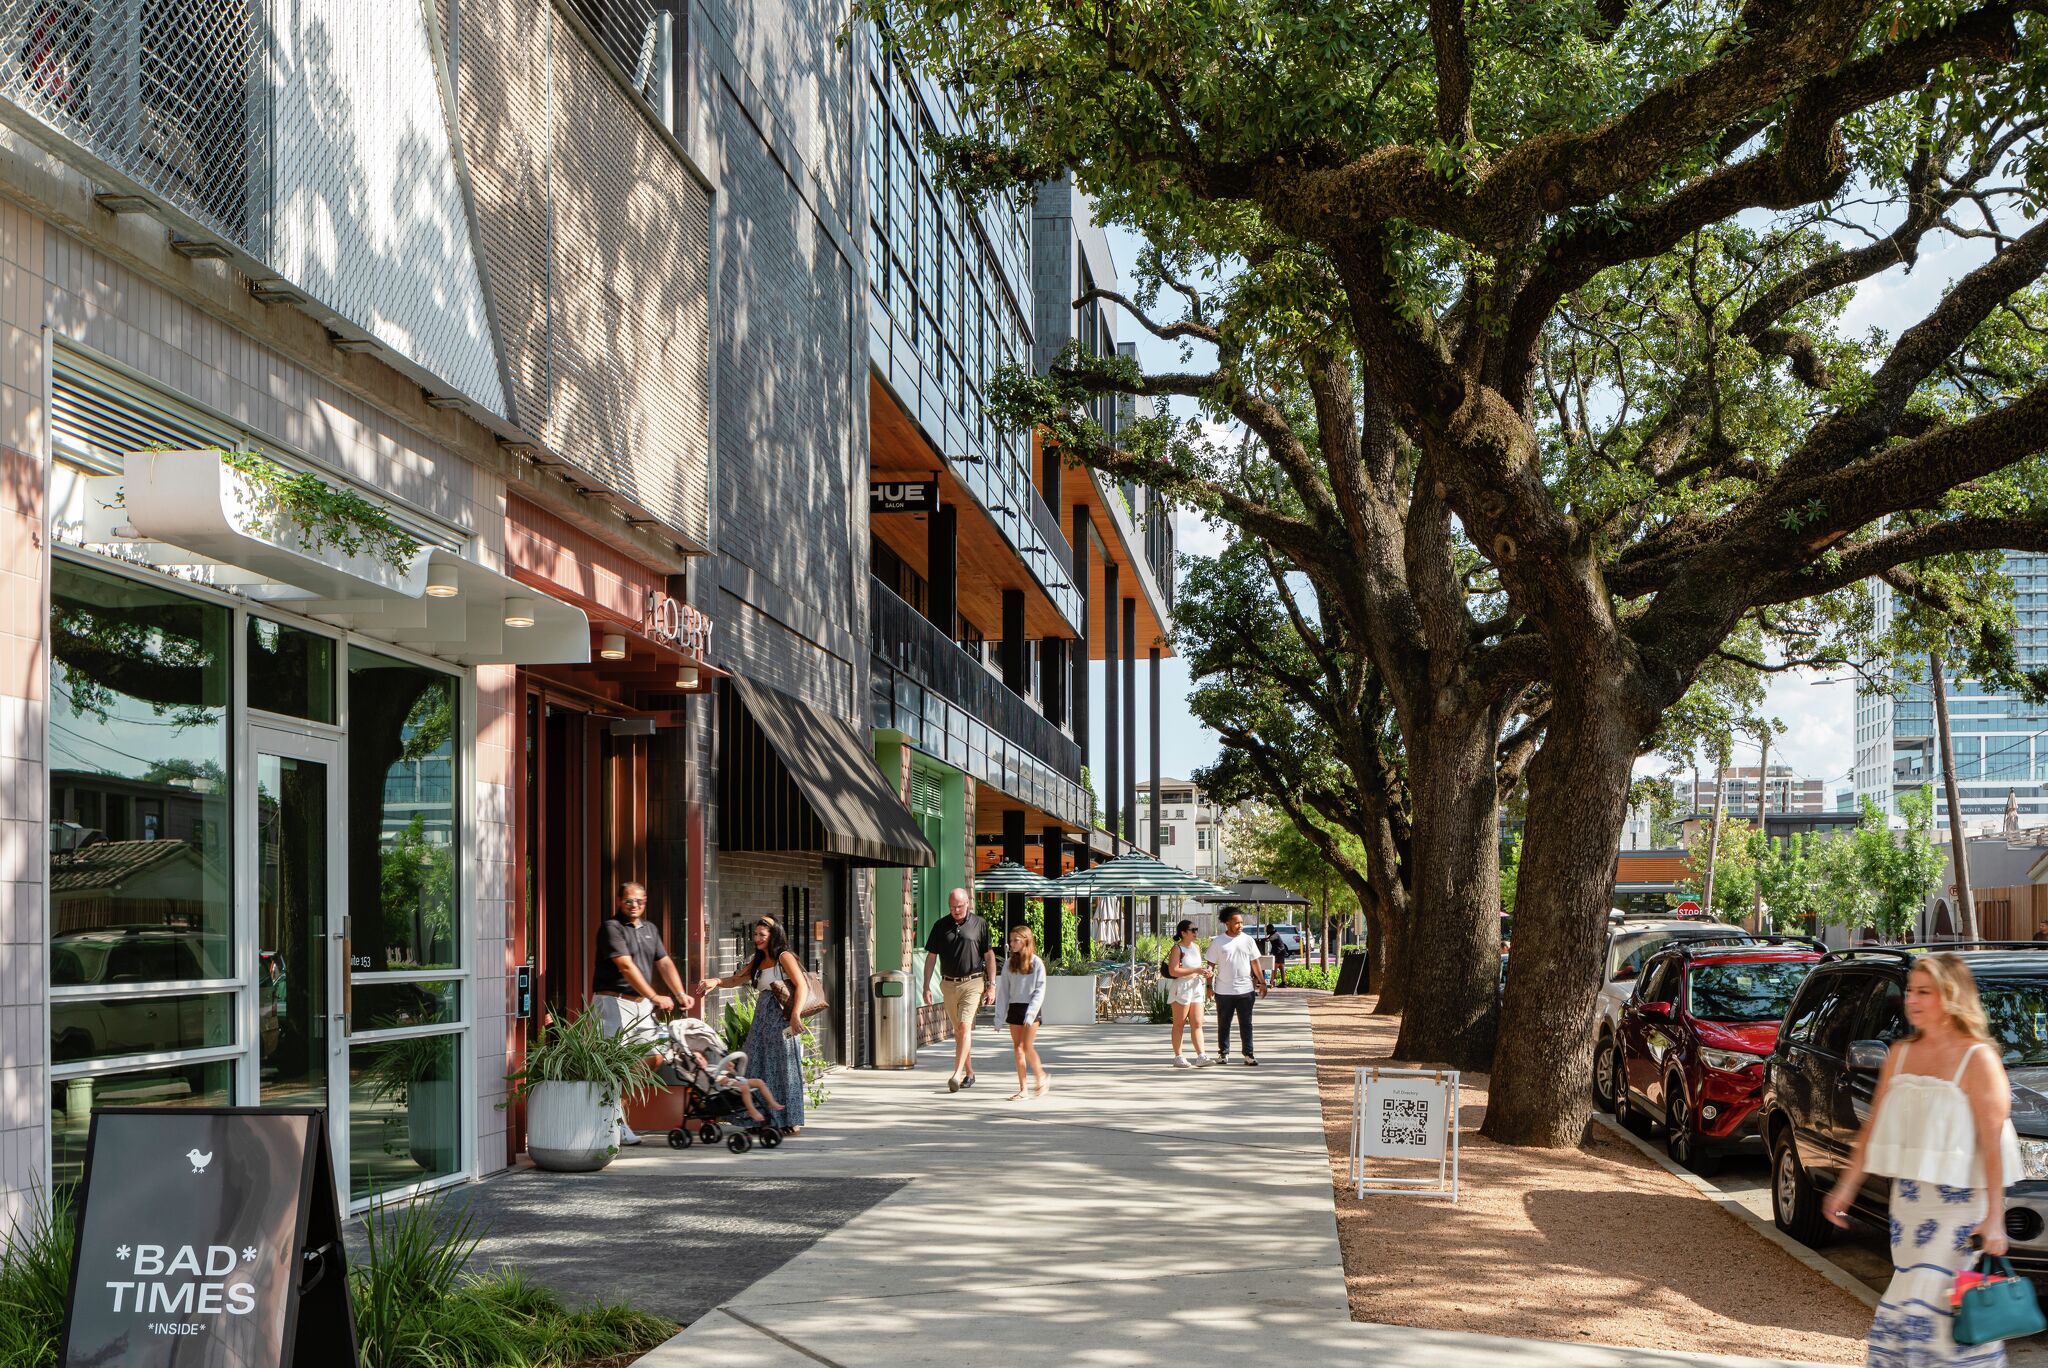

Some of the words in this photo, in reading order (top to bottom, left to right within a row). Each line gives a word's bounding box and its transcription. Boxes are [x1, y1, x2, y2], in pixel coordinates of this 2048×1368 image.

[870, 485, 924, 501] HUE
[652, 590, 713, 658] LOBBY
[360, 956, 371, 968] 153
[105, 1281, 256, 1314] TIMES
